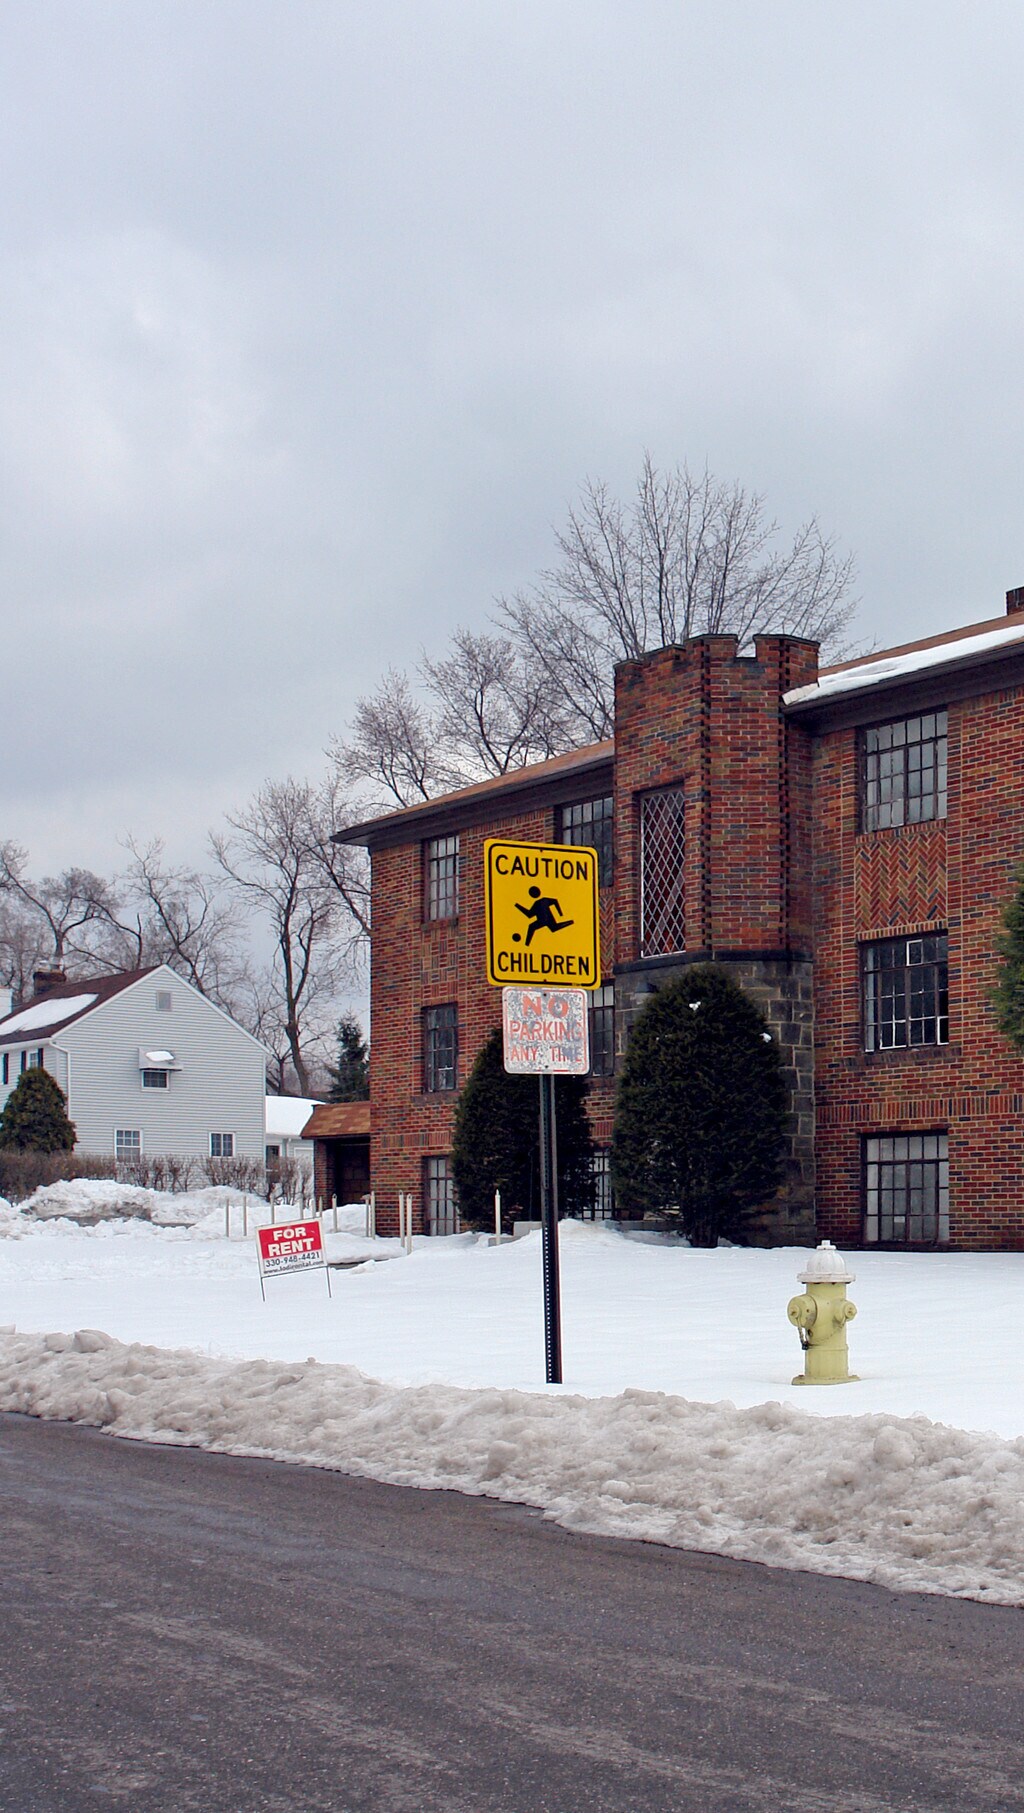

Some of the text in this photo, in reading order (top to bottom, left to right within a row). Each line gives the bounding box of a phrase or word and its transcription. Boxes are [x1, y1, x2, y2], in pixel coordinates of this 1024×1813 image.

[495, 854, 588, 881] CAUTION
[497, 951, 590, 976] CHILDREN
[522, 995, 569, 1018] NO
[509, 1020, 582, 1041] PARKING
[510, 1045, 539, 1062] ANY
[273, 1227, 307, 1241] FOR
[268, 1238, 314, 1257] RENT
